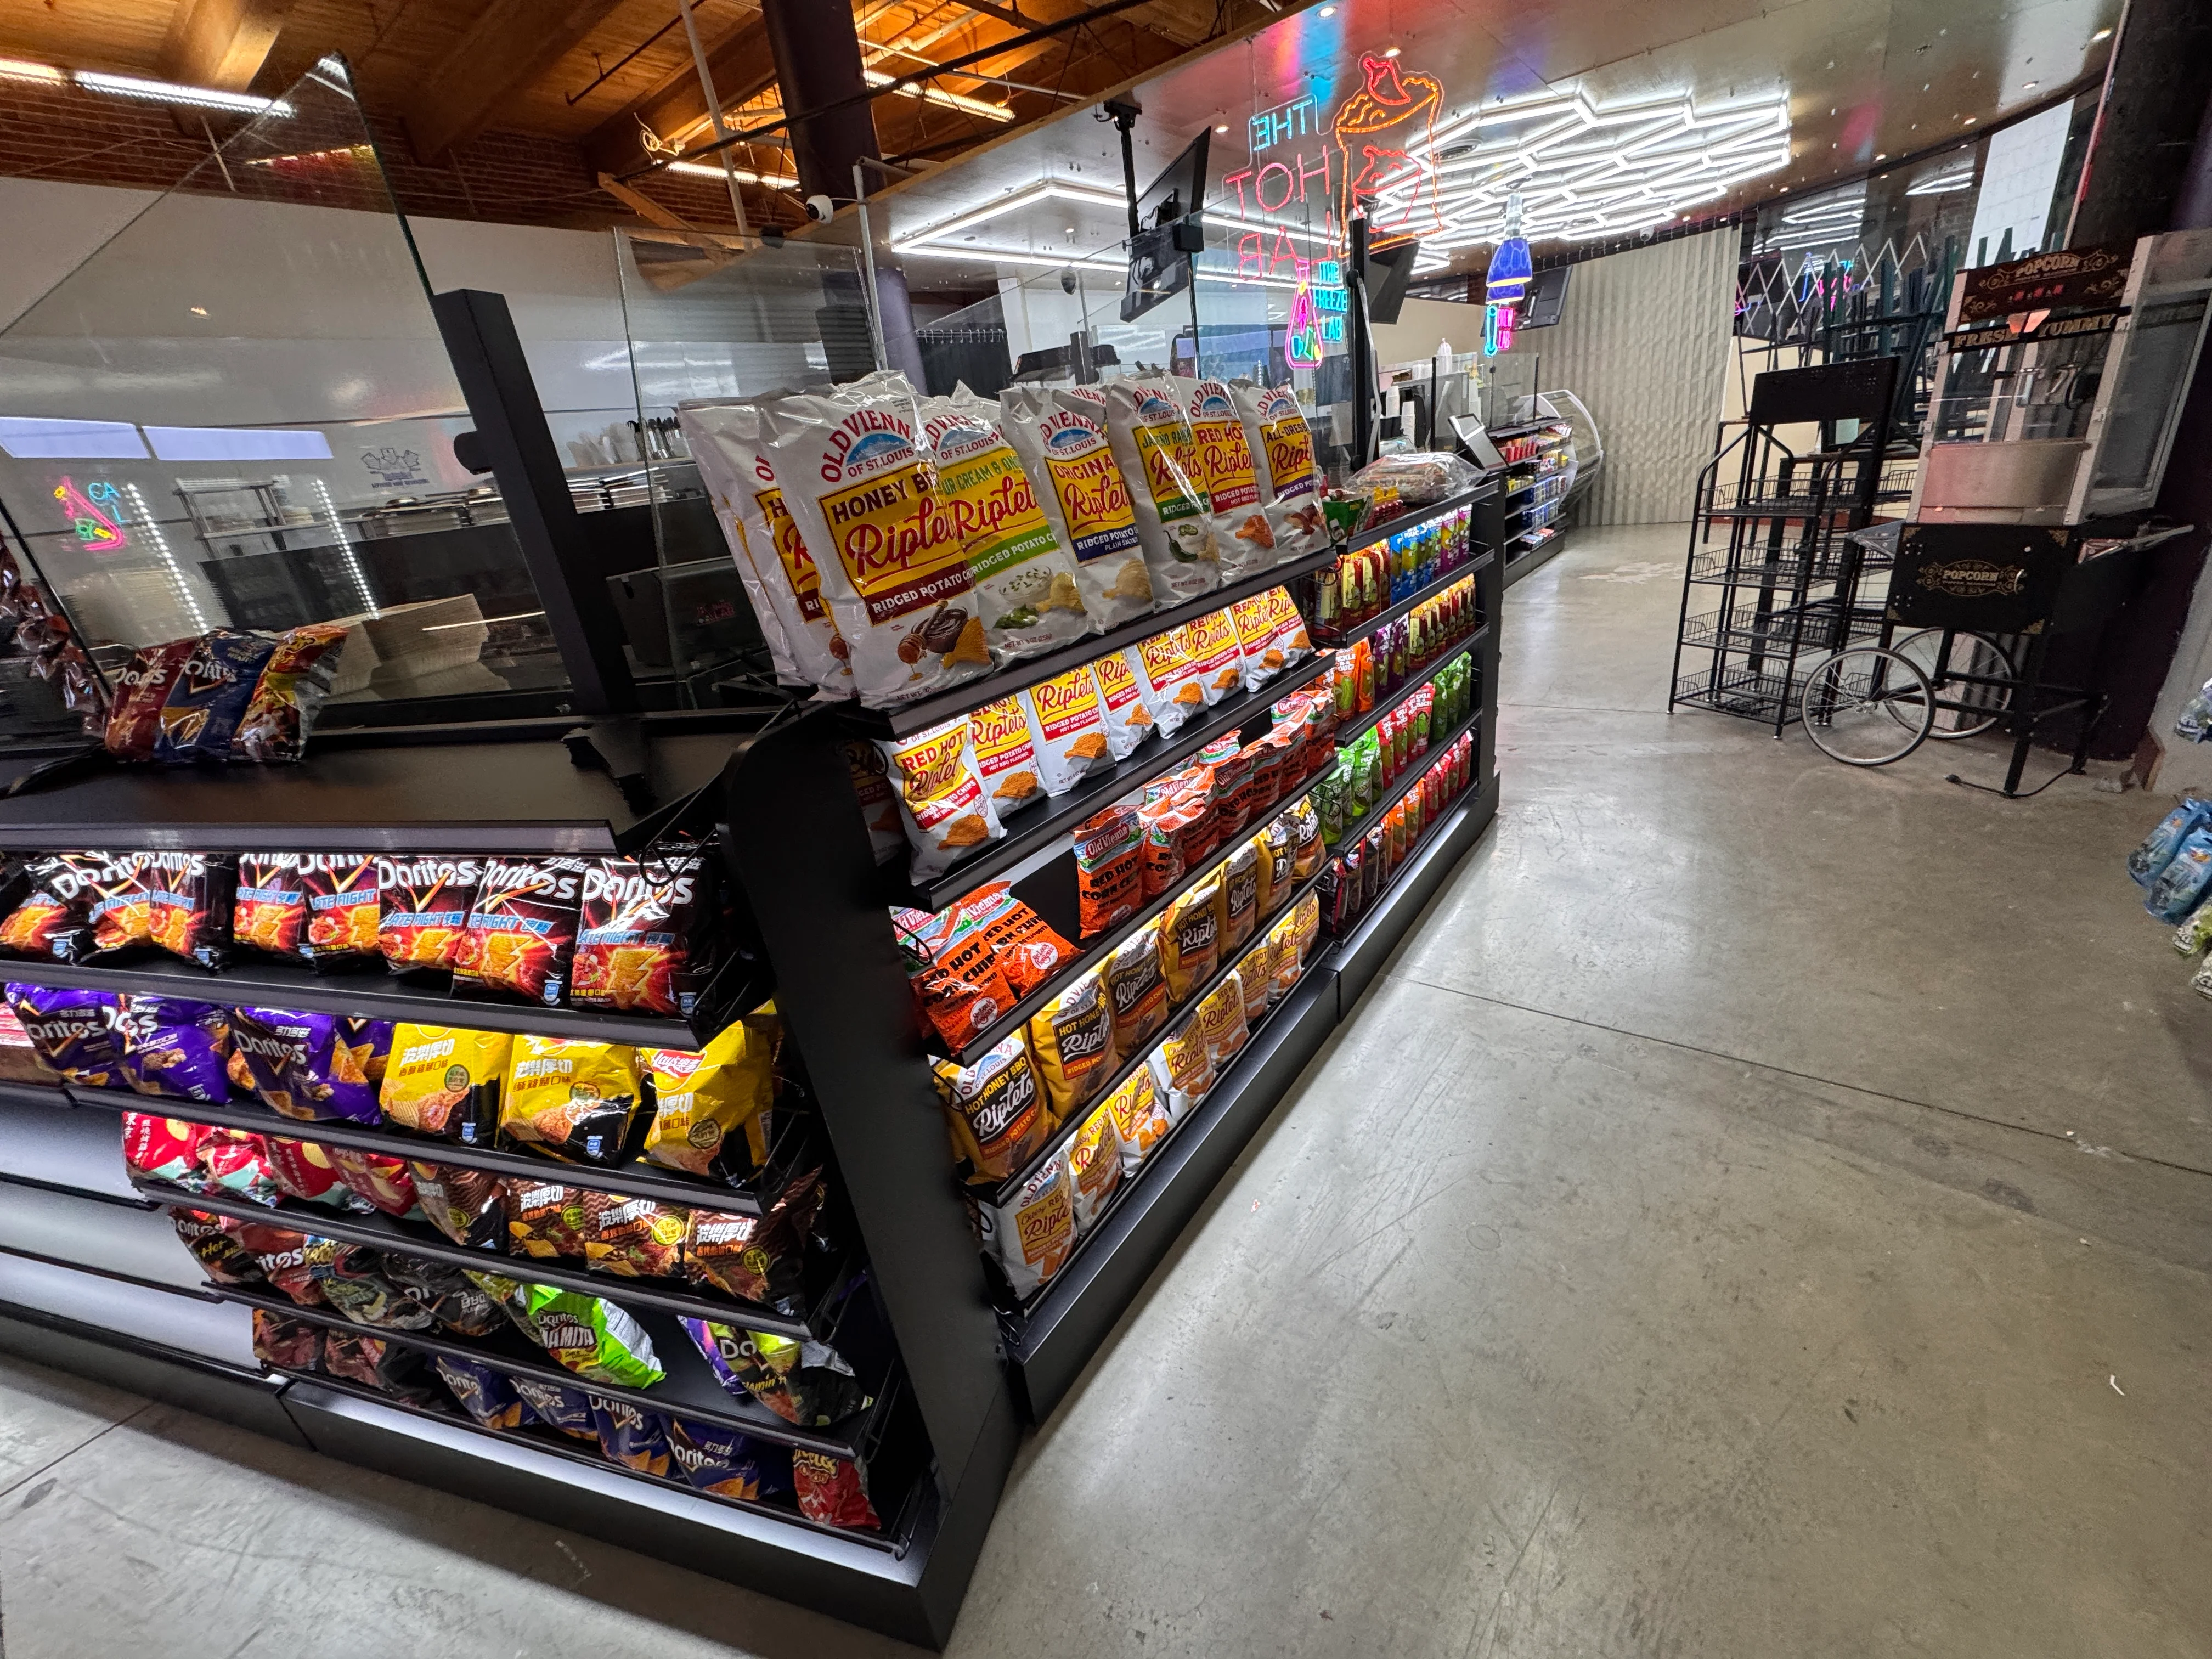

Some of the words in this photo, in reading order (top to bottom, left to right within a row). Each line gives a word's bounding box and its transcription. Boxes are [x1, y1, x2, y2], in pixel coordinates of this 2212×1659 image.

[1313, 289, 1347, 312] FREEZE
[1322, 315, 1342, 340] LAB
[1190, 389, 1204, 418] OLD
[1196, 427, 1223, 445] RED
[1223, 426, 1244, 442] HO
[1266, 422, 1307, 443] ALL-DRESS
[821, 430, 851, 483] OLD
[940, 450, 953, 461] OF
[1053, 453, 1116, 480] ORIGINA
[1204, 441, 1252, 478] Riple
[847, 464, 864, 478] OF
[956, 464, 994, 490] CREAM
[830, 479, 910, 525] HONEY
[949, 475, 1040, 540] Riplet
[1064, 474, 1130, 522] Riplet
[1214, 487, 1240, 503] RIDGED
[1161, 502, 1190, 516] RIDGED
[845, 496, 956, 577] Riplet
[1076, 532, 1110, 551] RIDGED
[1110, 526, 1135, 541] POTATO
[1104, 540, 1121, 551] PLAIN
[972, 546, 1011, 575] RIDGED
[1011, 534, 1046, 555] POTATO
[872, 590, 919, 614] RIDGED
[921, 573, 963, 597] POTATO
[1238, 602, 1268, 635] Riplet
[1036, 672, 1095, 712] Riplets
[1125, 684, 1139, 695] POTA
[971, 707, 1028, 747] Riplets
[1045, 719, 1070, 733] RIDGED
[1070, 713, 1089, 725] POTATO
[911, 734, 921, 743] OF
[901, 746, 938, 774] RED
[939, 730, 965, 755] HOT
[978, 755, 999, 769] IDGED
[999, 748, 1021, 763] POTATO
[956, 779, 977, 797] CHIPS
[1172, 778, 1192, 793] Vien
[1087, 840, 1103, 856] Old
[1103, 823, 1128, 848] Vienna
[52, 851, 151, 900] Dorito
[379, 859, 478, 889] Doritos
[485, 860, 580, 900] Doritos
[1090, 870, 1114, 888] RED
[1114, 855, 1138, 876] HOT
[336, 888, 376, 907] NIGHT
[582, 868, 695, 905] Doritos
[413, 912, 442, 927] NIGHT
[483, 915, 522, 930] NIGHT
[1006, 907, 1031, 927] HOT
[601, 930, 645, 945] NIGHT
[948, 941, 981, 972] HOT
[1255, 951, 1267, 961] HOT
[1217, 988, 1228, 1001] RED
[1070, 1007, 1080, 1015] OF
[1203, 991, 1240, 1028] Riplets
[27, 1020, 108, 1039] oritos
[1059, 1021, 1078, 1037] HOT
[233, 1029, 306, 1065] Doritos
[1067, 1060, 1091, 1075] RIDGED
[961, 1069, 976, 1096] OLD
[965, 1097, 985, 1115] HOT
[983, 1071, 1011, 1102] HONEY
[1010, 1056, 1028, 1076] BBQ
[973, 1067, 1034, 1138] Riplets
[1152, 1105, 1163, 1117] HOT
[1010, 1116, 1031, 1139] POTATO
[1088, 1120, 1103, 1135] RED
[1020, 1182, 1037, 1207] OLD
[1047, 1190, 1064, 1208] RED
